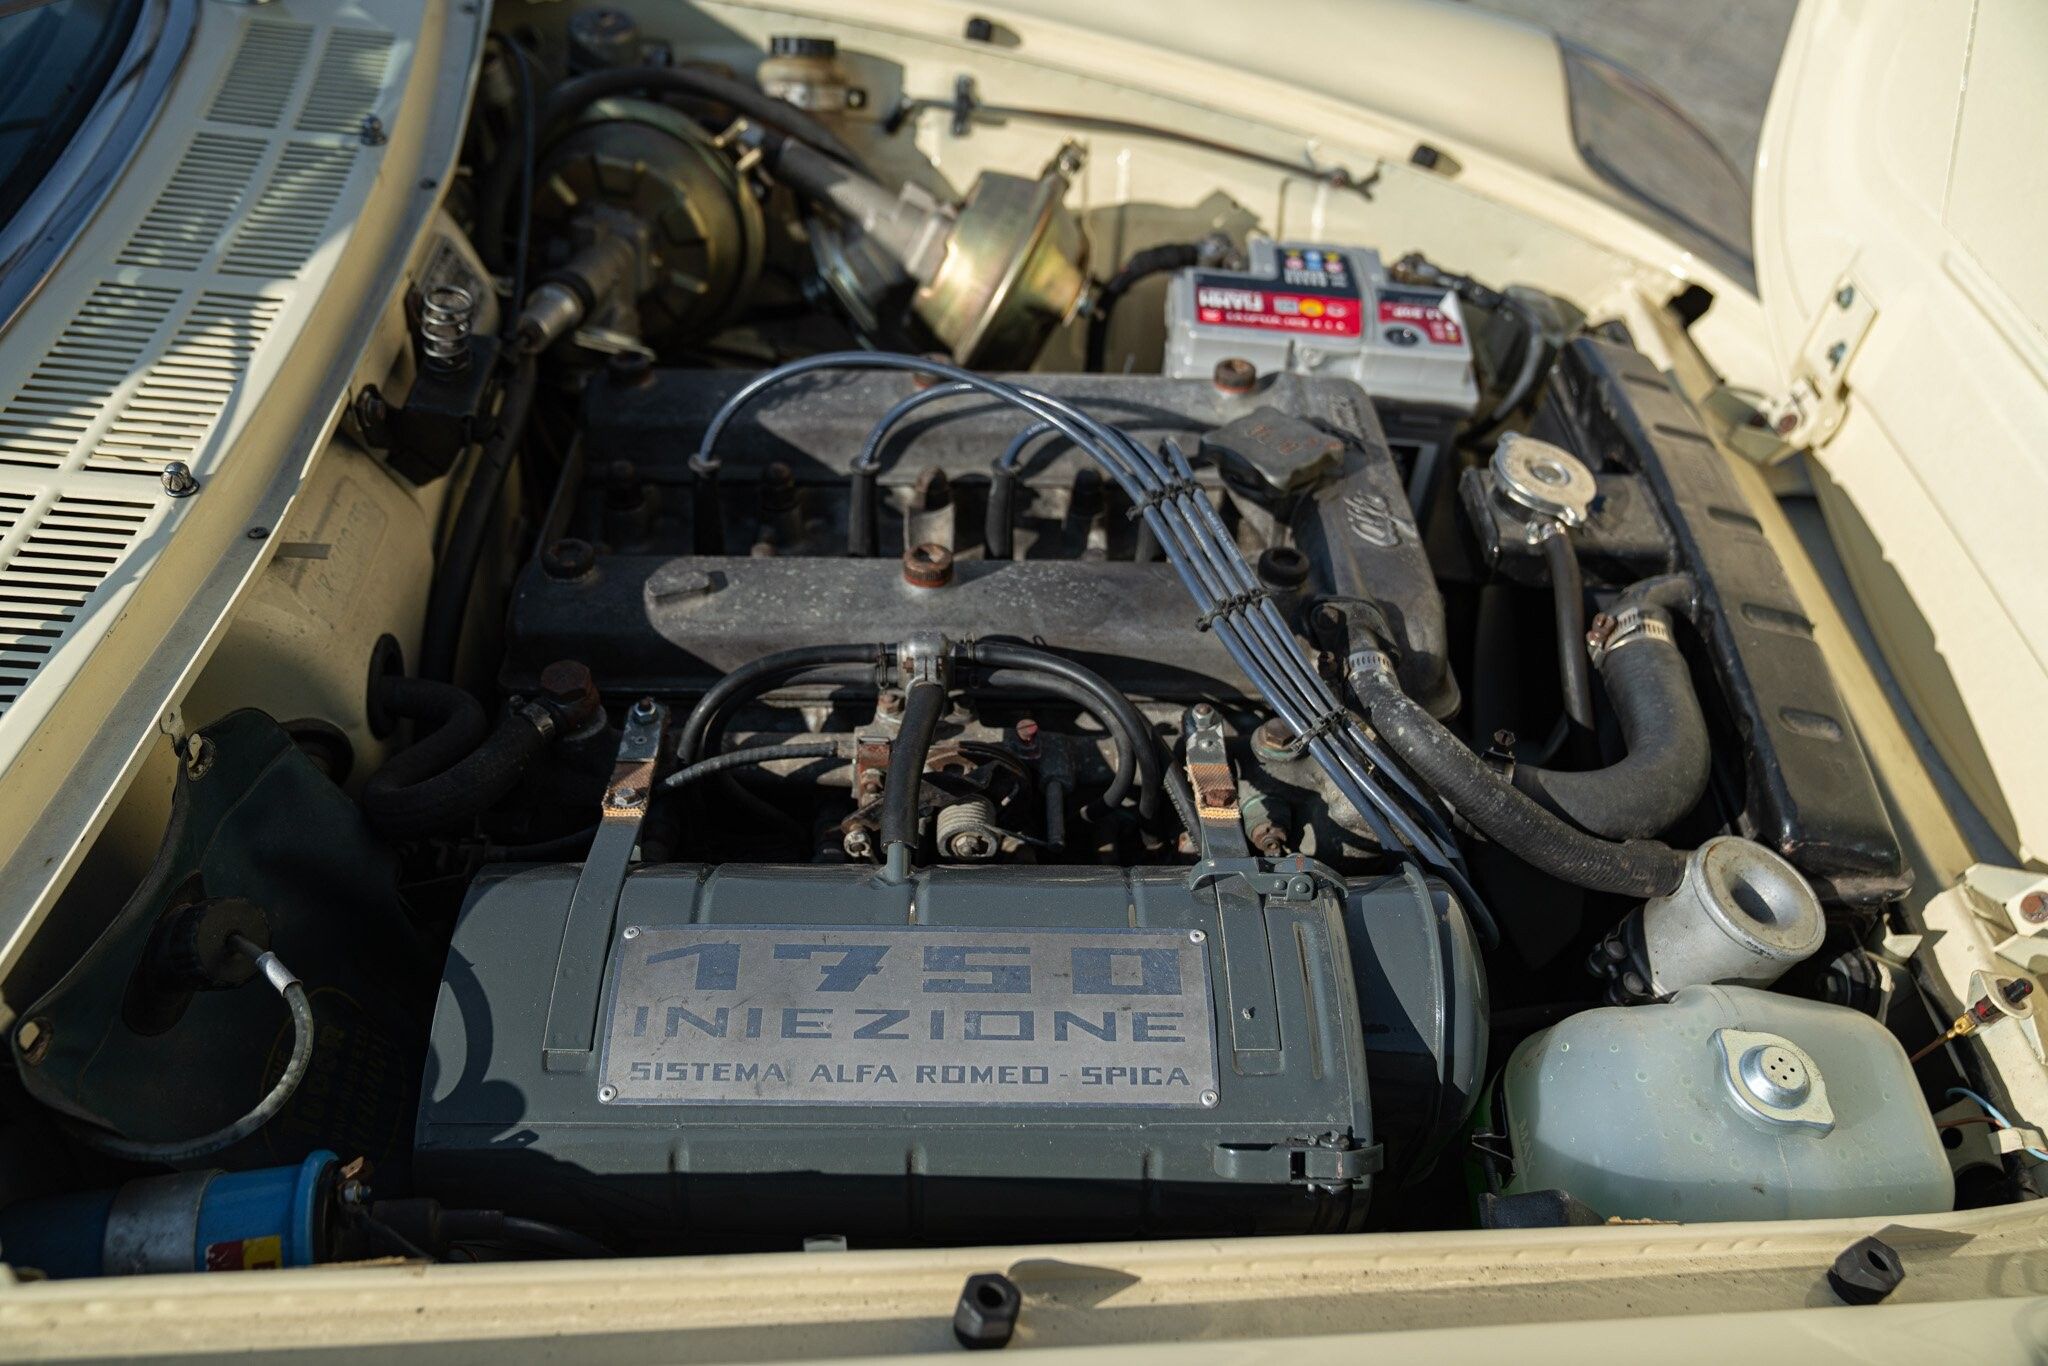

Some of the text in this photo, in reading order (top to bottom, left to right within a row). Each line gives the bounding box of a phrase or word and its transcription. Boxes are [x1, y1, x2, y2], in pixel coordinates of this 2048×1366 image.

[646, 943, 1183, 996] 1750
[633, 1006, 1186, 1042] INIEZIONE
[629, 1061, 786, 1082] SISTEMA
[808, 1064, 898, 1084] ALFA
[915, 1065, 1049, 1085] ROMEO
[1080, 1066, 1190, 1086] SPICA
